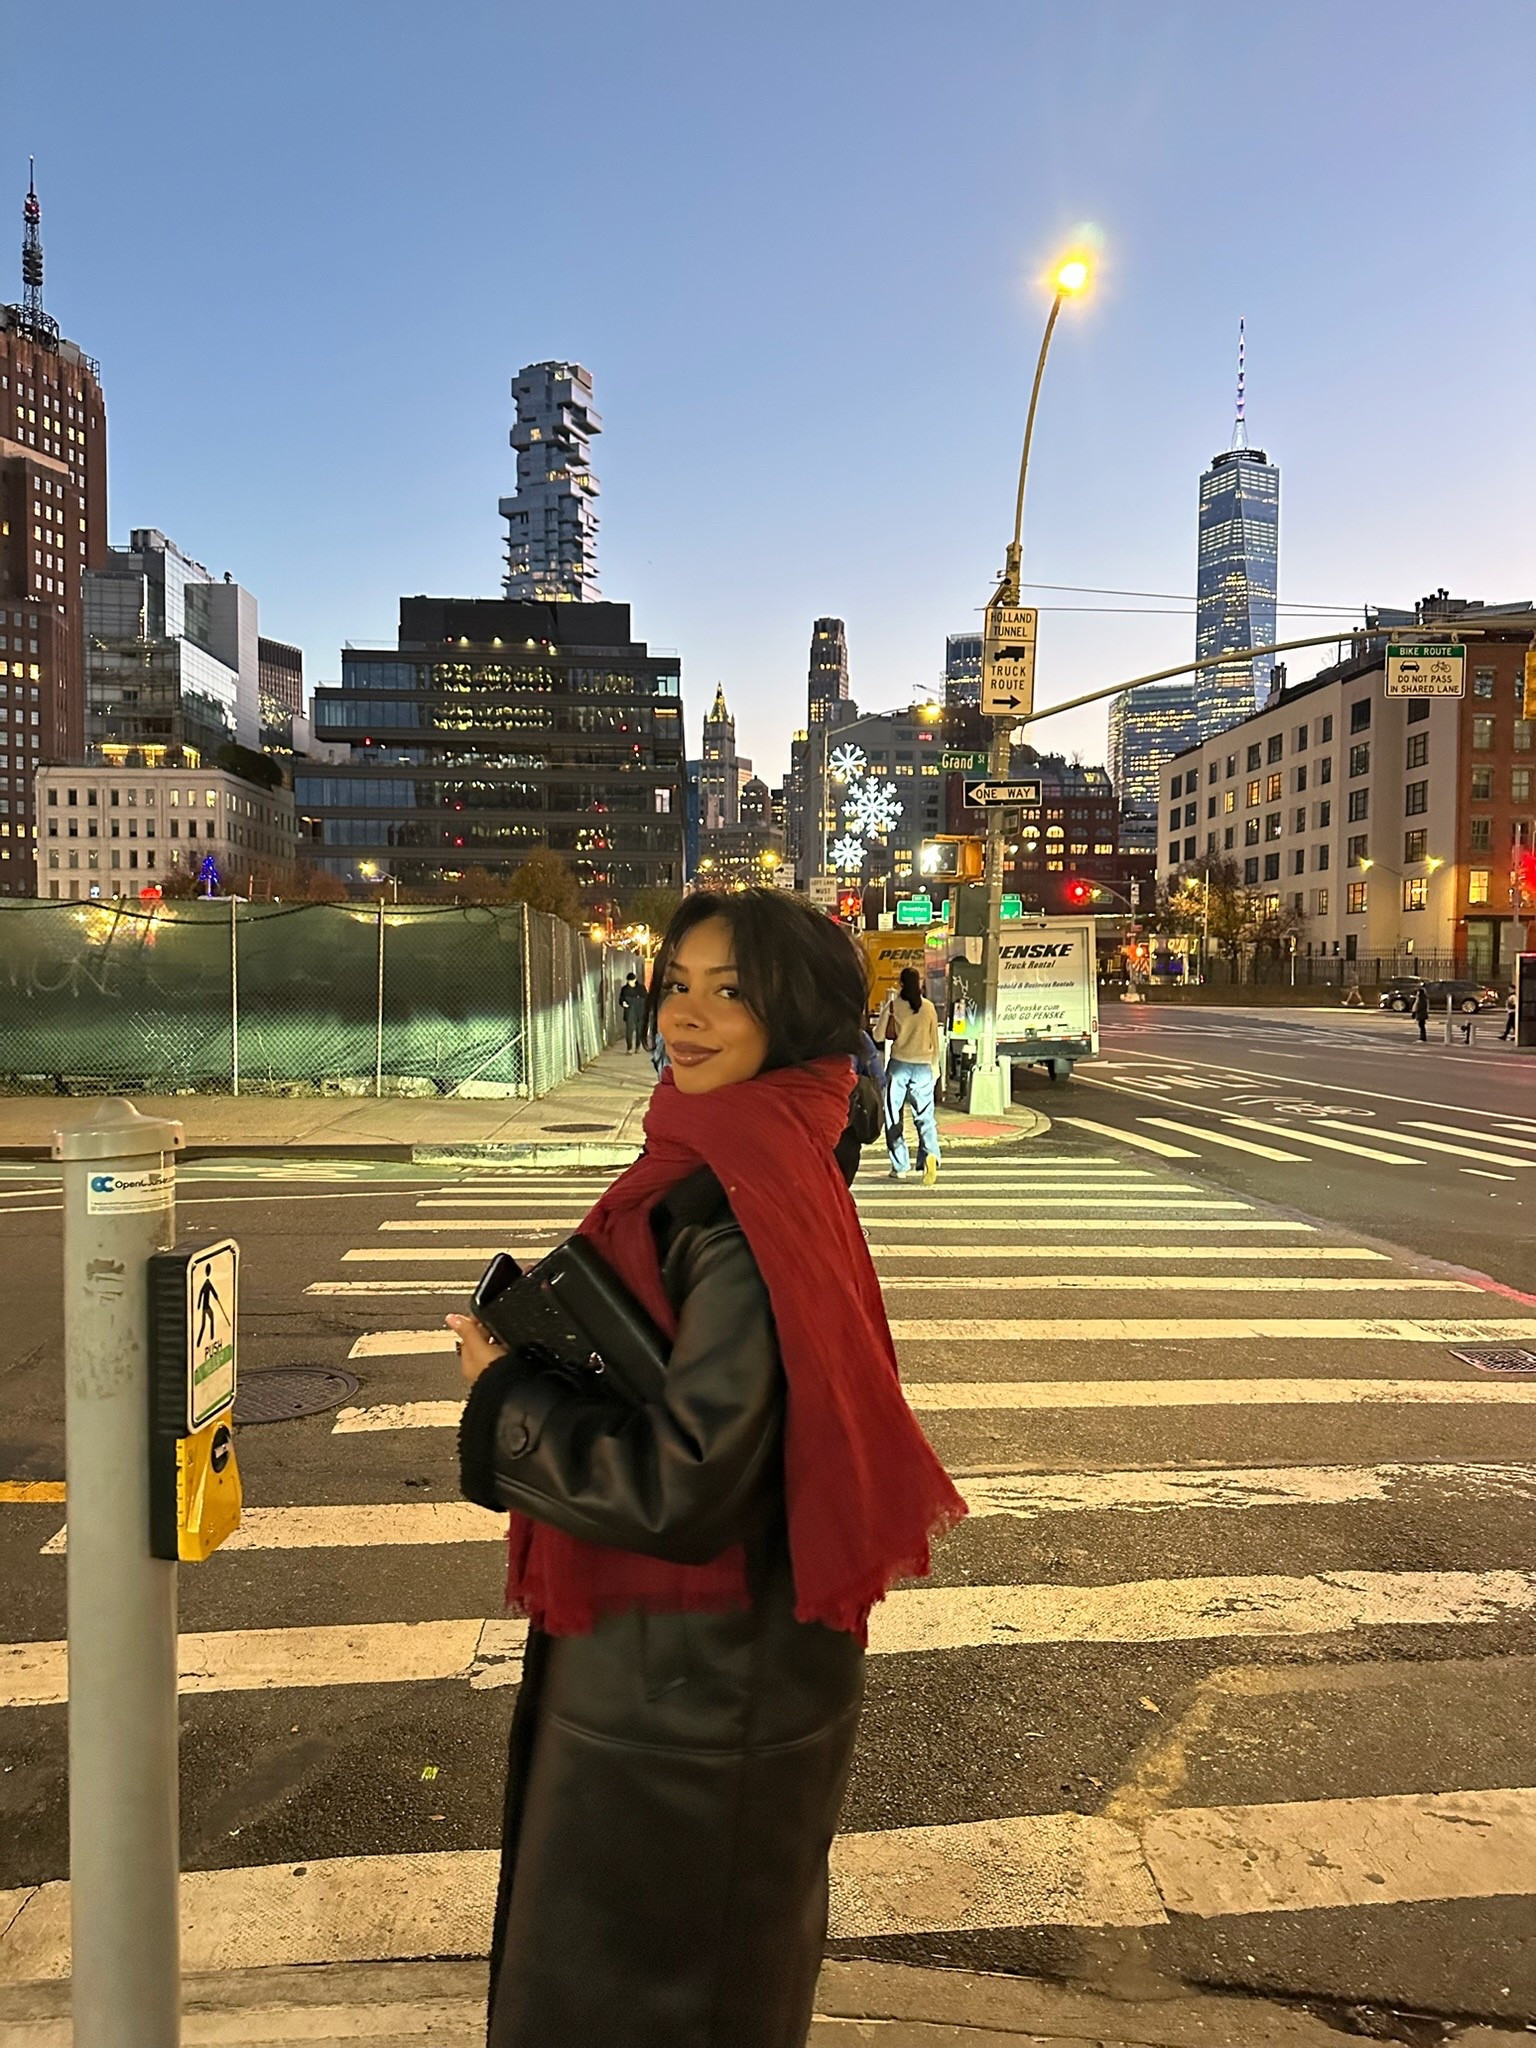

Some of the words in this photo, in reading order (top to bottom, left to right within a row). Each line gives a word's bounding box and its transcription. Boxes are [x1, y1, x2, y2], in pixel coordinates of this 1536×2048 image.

[991, 612, 1032, 623] HOLLAND
[994, 626, 1028, 637] TUNNEL
[1399, 647, 1420, 656] BIKE
[1423, 647, 1452, 656] ROUTE
[991, 665, 1026, 677] TRUCK
[990, 679, 1025, 690] ROUTE
[1397, 675, 1409, 683] DO
[1411, 675, 1428, 683] NOT
[1430, 675, 1452, 683] PASS
[1390, 685, 1398, 693] IN
[1401, 685, 1434, 693] SHARED
[1437, 685, 1460, 693] LANE
[941, 753, 974, 770] Grand
[977, 754, 986, 764] St
[975, 788, 997, 799] ONE
[1007, 788, 1031, 798] WAY
[815, 887, 831, 895] MUST
[878, 949, 925, 961] PENS
[1004, 960, 1026, 970] Truck
[1027, 959, 1056, 969] Rental
[1052, 980, 1075, 988] Rentals
[204, 1338, 222, 1360] PUSH
